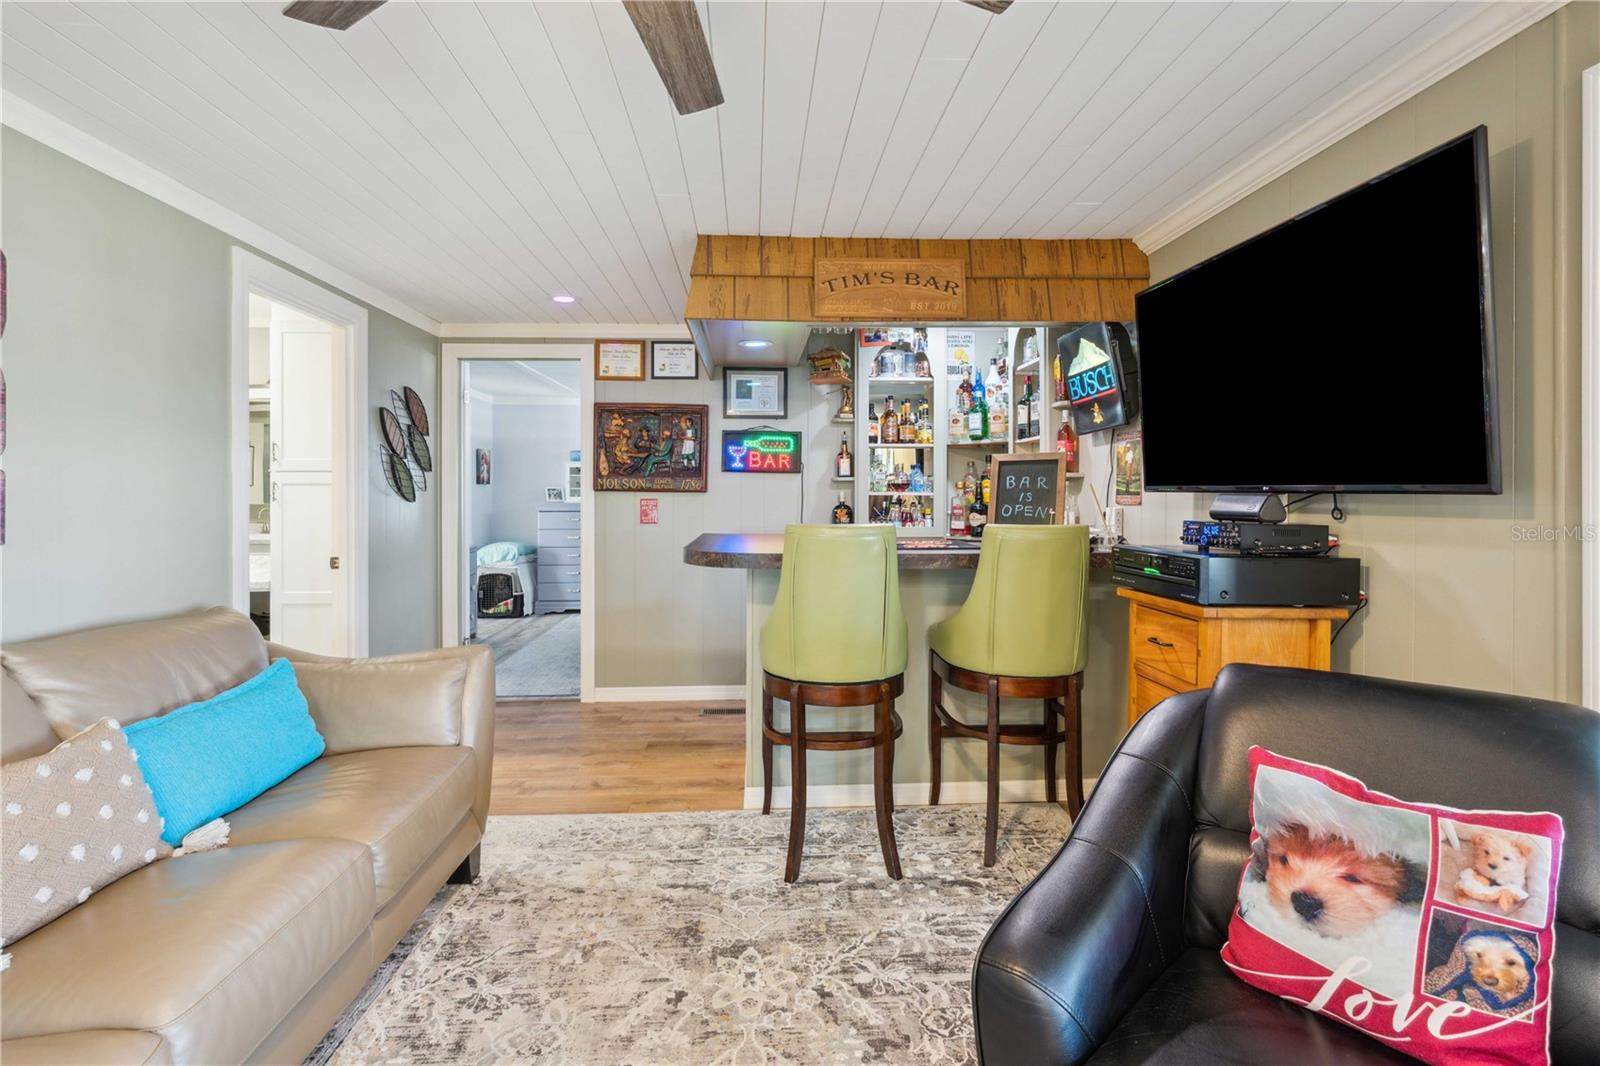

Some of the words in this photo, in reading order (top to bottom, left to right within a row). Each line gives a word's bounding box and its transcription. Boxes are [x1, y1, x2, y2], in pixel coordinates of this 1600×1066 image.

[822, 271, 895, 293] TIM'S
[904, 272, 960, 296] BAR
[1068, 364, 1116, 400] BUSCH
[749, 451, 790, 469] BAR
[597, 478, 646, 490] MOLSON
[1006, 475, 1048, 489] BAR
[1019, 492, 1033, 502] IS
[1001, 504, 1048, 519] OPEN
